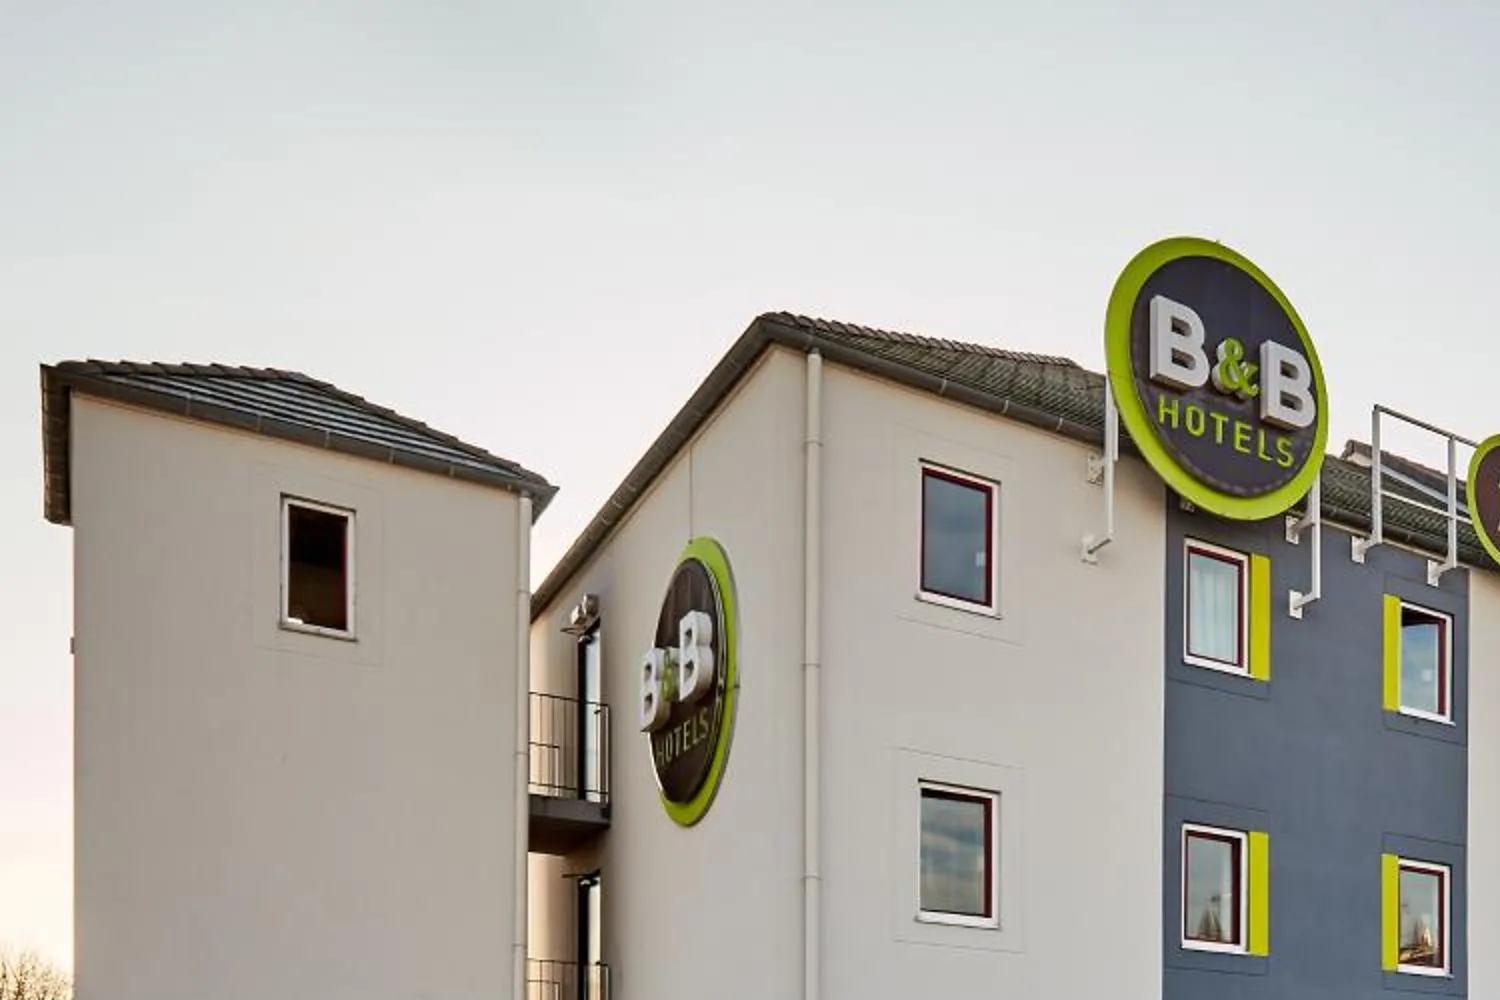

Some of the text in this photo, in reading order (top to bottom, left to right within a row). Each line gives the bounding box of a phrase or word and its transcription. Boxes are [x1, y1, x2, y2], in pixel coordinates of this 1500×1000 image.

[1150, 295, 1317, 428] B&B
[1159, 394, 1296, 468] HOTELS
[656, 708, 709, 767] HOTELS
